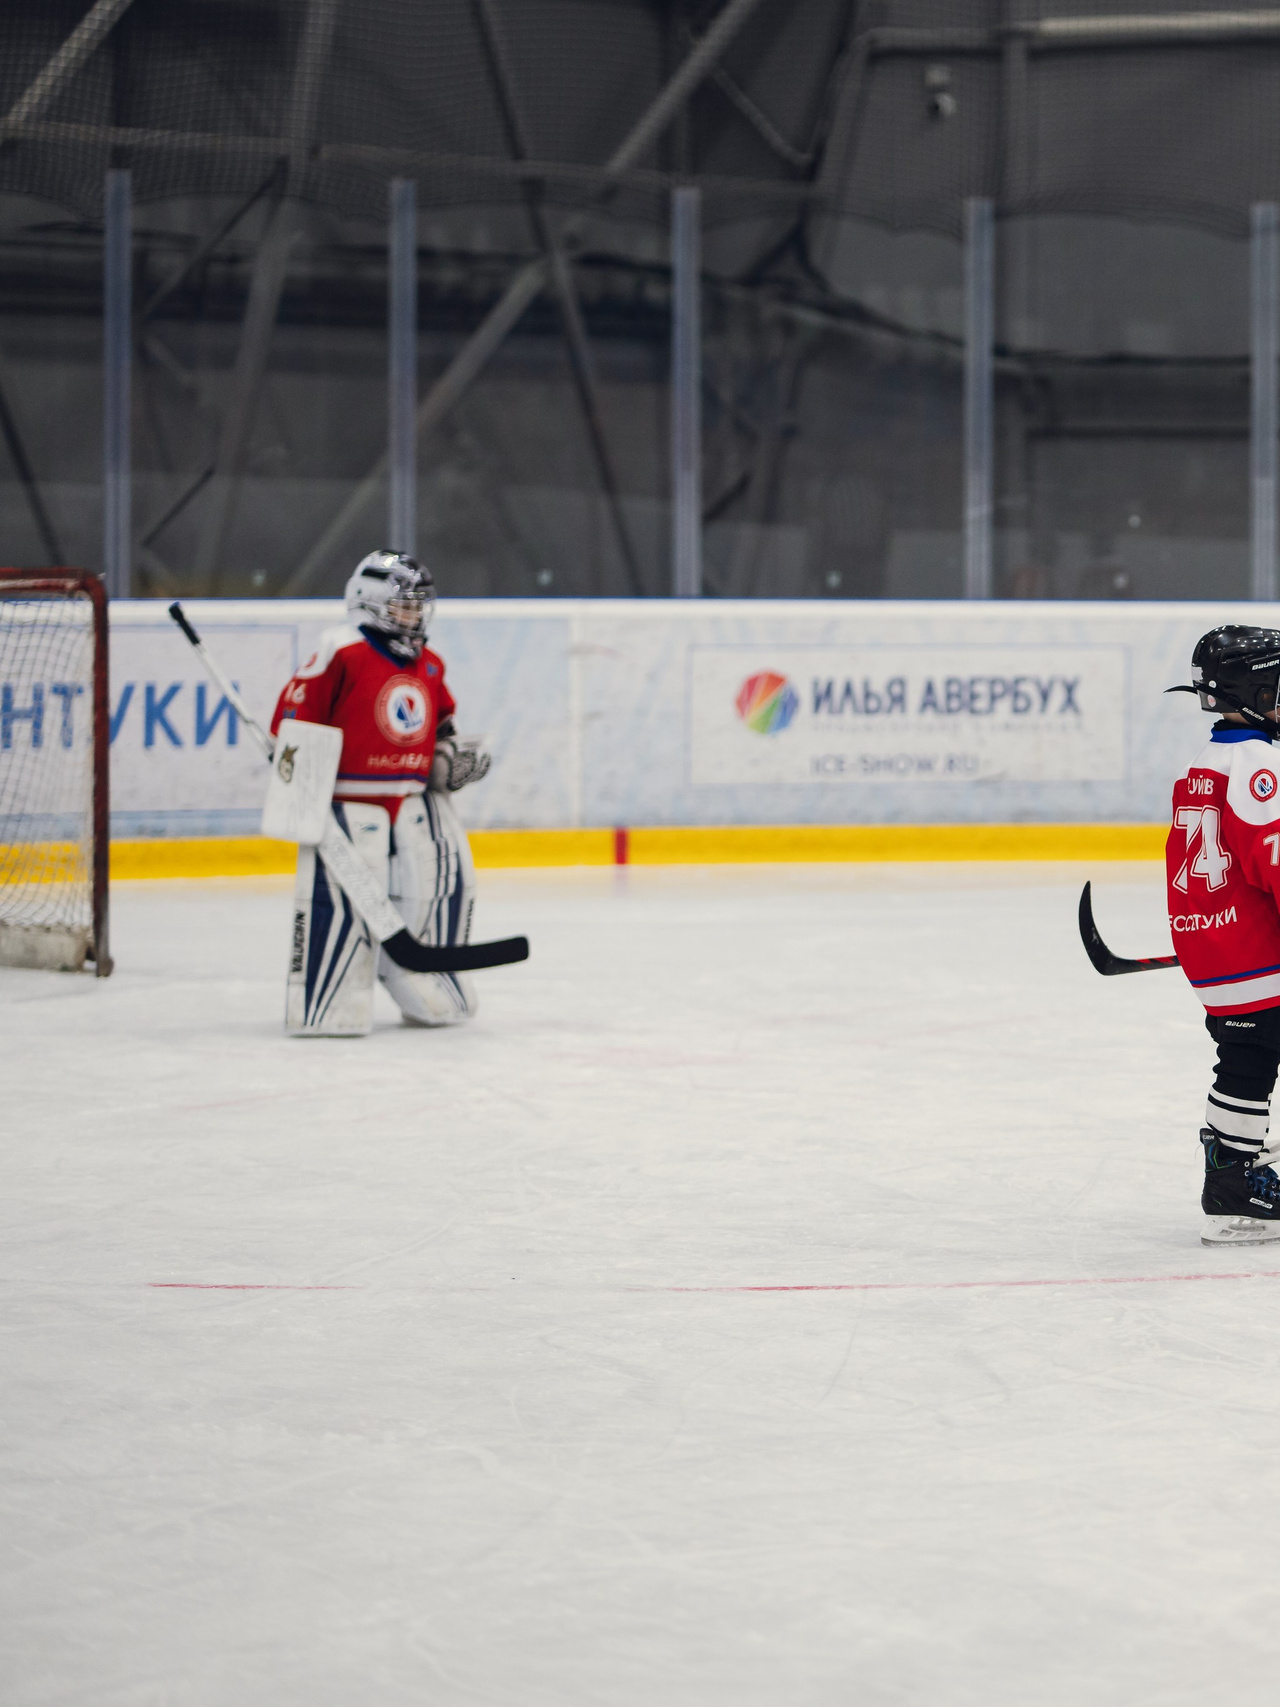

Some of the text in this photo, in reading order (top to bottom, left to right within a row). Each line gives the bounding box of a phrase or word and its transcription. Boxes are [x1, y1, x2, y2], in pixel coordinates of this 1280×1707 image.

[811, 677, 1082, 716] ИЛЬЯ АВЕРБУХ
[1173, 805, 1232, 894] 74
[1225, 1020, 1256, 1028] BAUER
